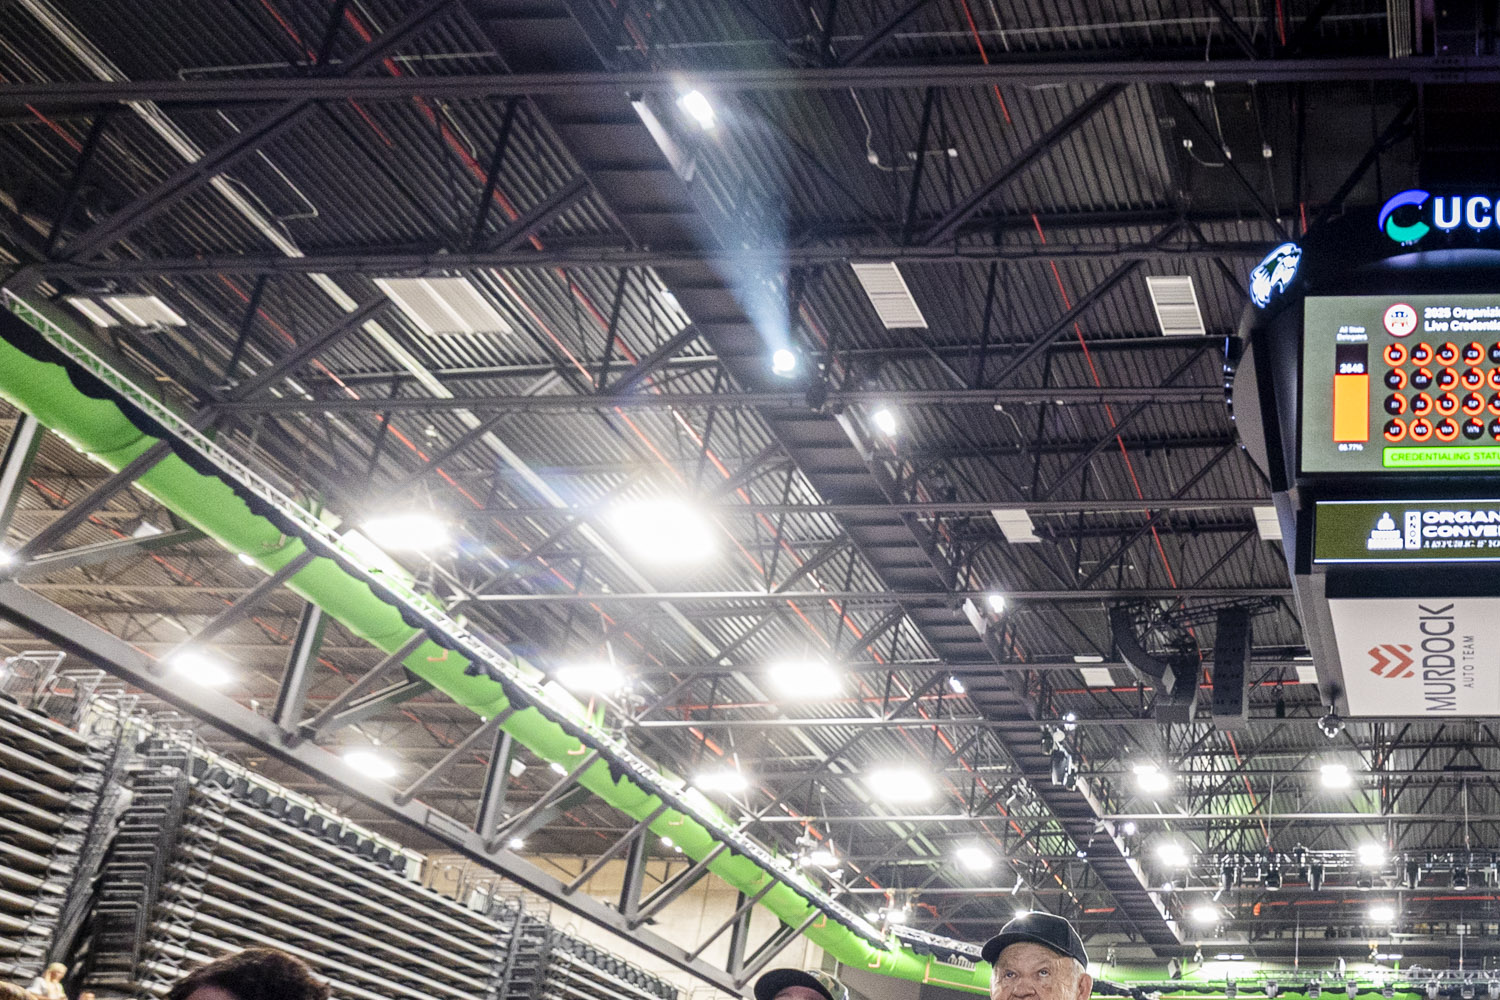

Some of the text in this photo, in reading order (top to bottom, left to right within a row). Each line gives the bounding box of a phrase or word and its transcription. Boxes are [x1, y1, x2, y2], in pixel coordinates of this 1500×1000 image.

[1424, 307, 1451, 318] 2025
[1424, 320, 1449, 331] Live
[1390, 452, 1471, 461] CREDENTIALING
[1476, 540, 1487, 548] IF
[1418, 603, 1457, 711] MURDOCK
[1462, 635, 1475, 688] AUTO TEAM
